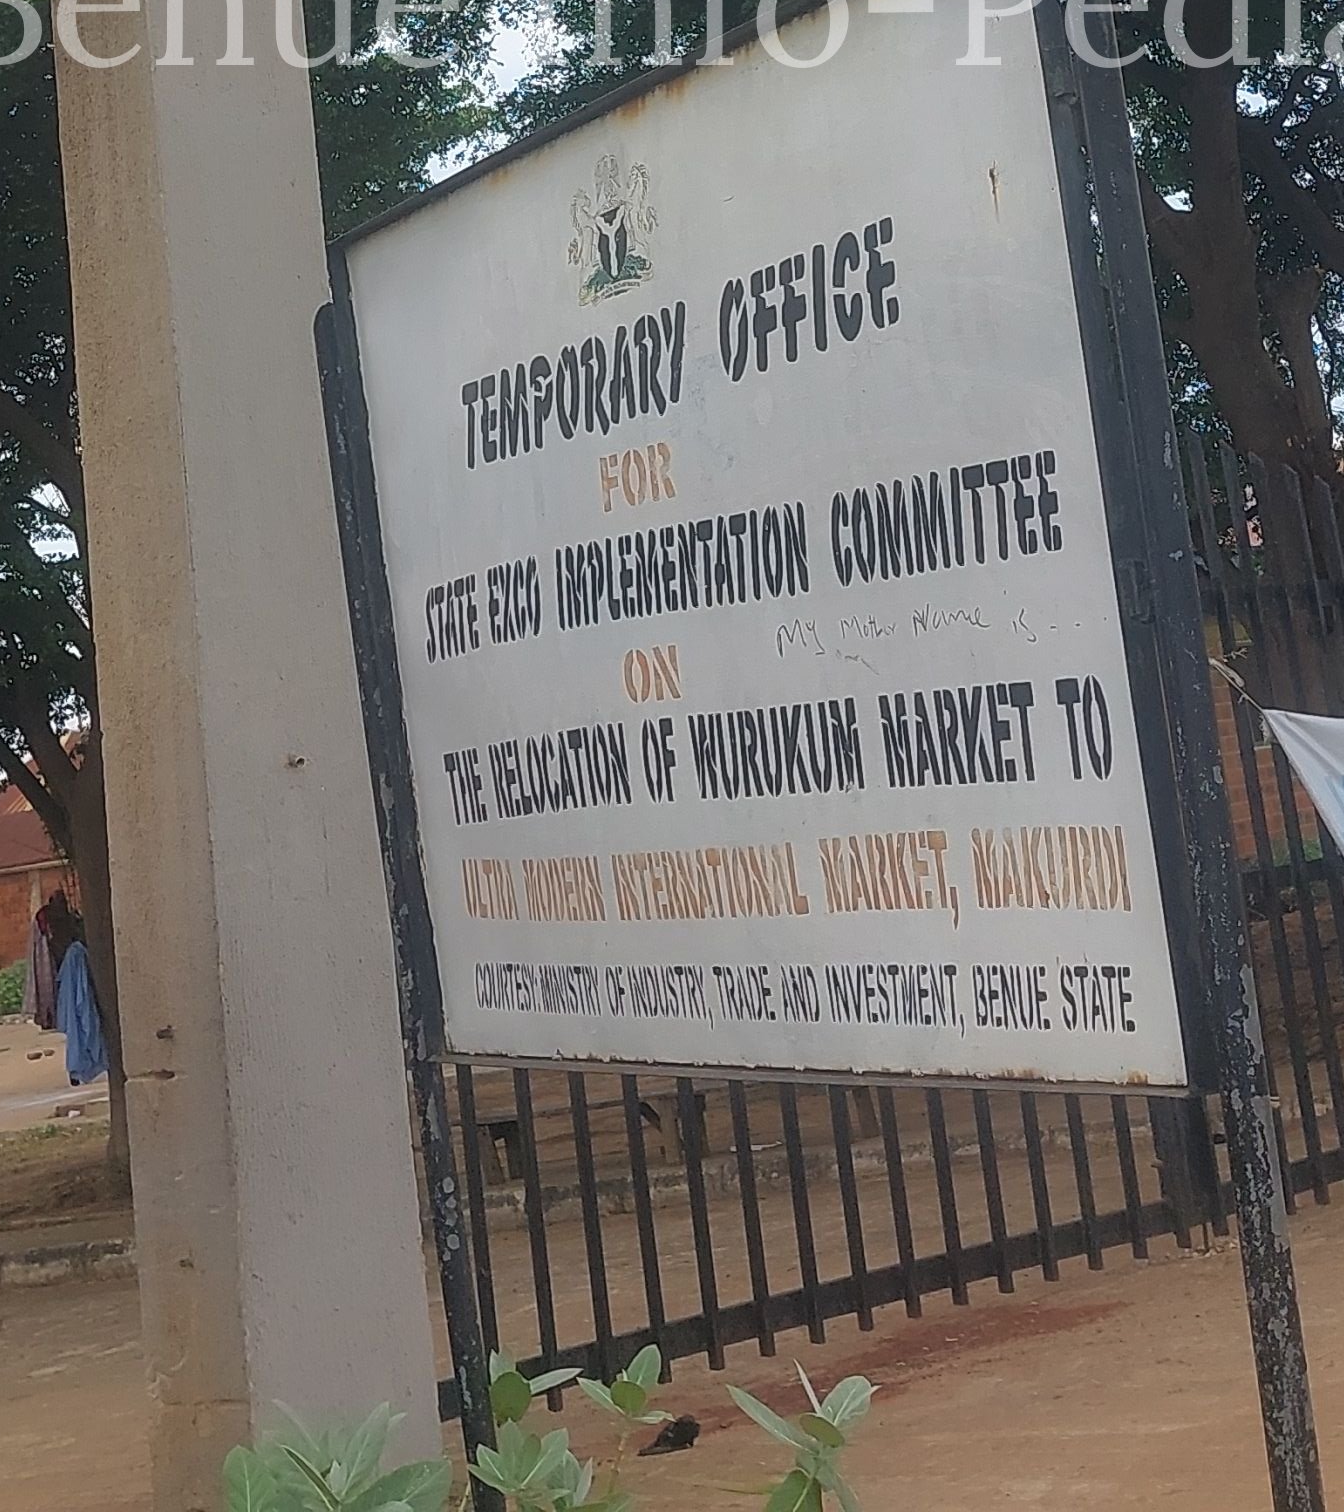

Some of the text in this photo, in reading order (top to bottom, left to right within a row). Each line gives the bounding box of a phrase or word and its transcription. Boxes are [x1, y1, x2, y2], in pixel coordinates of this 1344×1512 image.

[462, 216, 899, 469] TEMPORARY OFFICE
[598, 442, 676, 513] FOR
[425, 450, 1062, 662] STATE EXCO IMPLEMENTATION COMMITTEE
[624, 644, 682, 704] ON
[444, 674, 1113, 825] THE RELOCATION OF WURUKUM MARKET TO
[461, 825, 1132, 930] ULTRA MODERN INTERNATIONAL MARKET, MAKURDI
[540, 964, 601, 1017] MINISTRY
[607, 965, 629, 1017] OF
[631, 964, 713, 1030] INDUSTRY,
[713, 965, 776, 1022] TRADE
[782, 966, 819, 1024] AND
[827, 964, 965, 1036] INVESTMENT,
[974, 965, 1051, 1031] BENUE
[1060, 958, 1135, 1033] STATE
